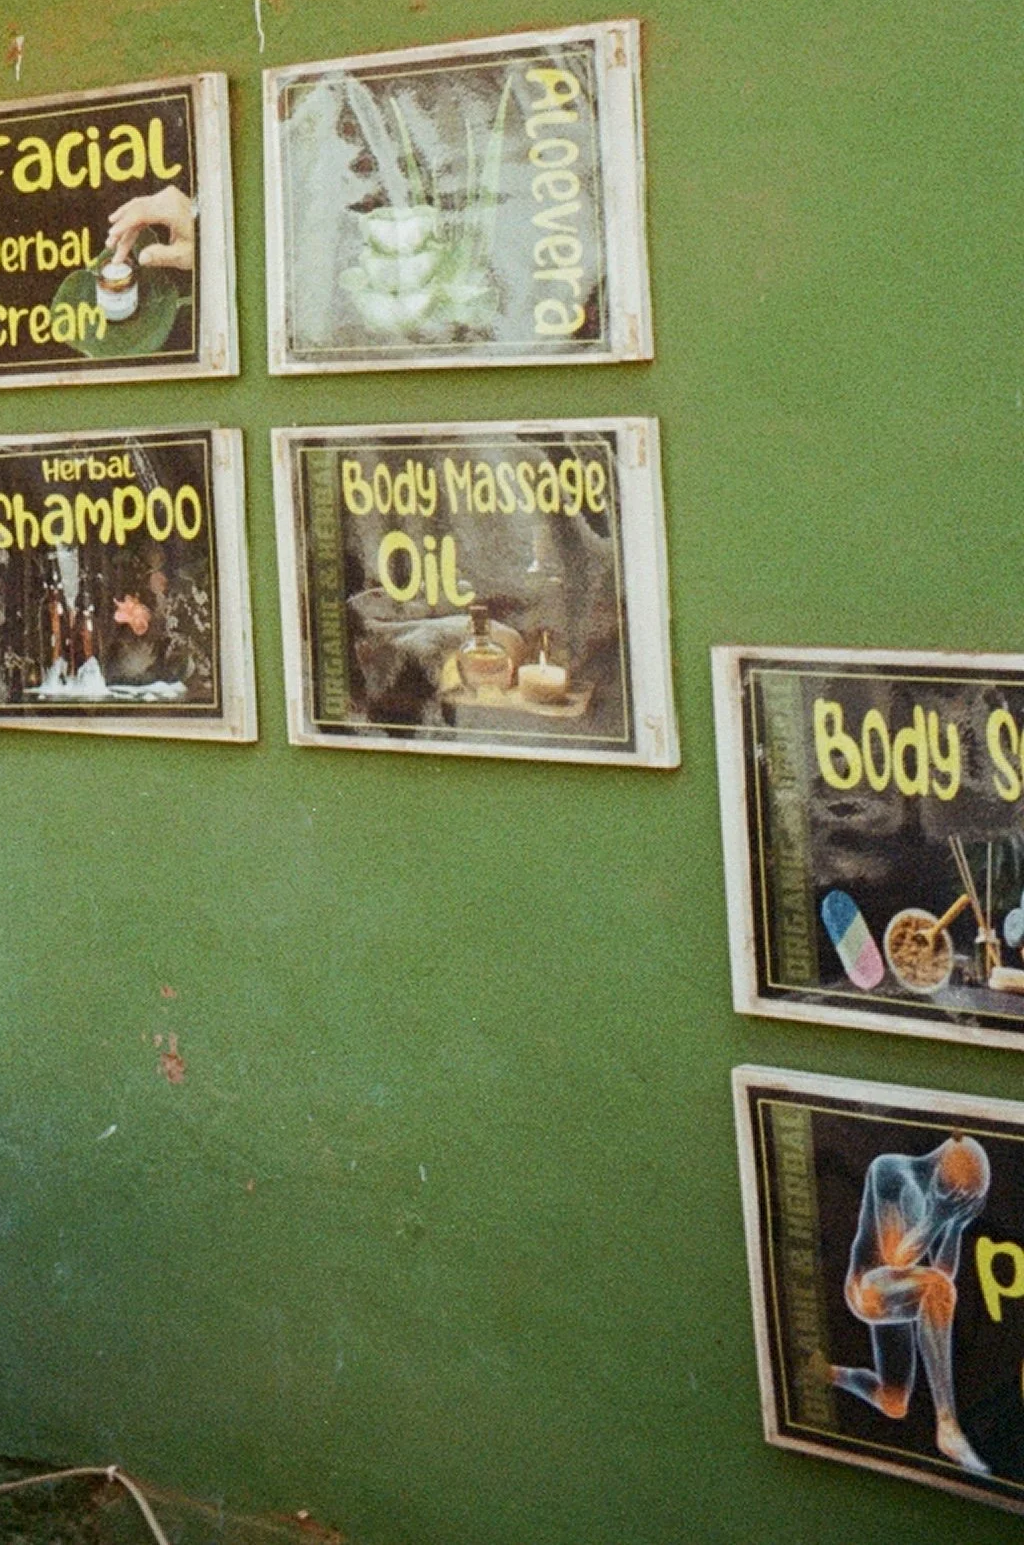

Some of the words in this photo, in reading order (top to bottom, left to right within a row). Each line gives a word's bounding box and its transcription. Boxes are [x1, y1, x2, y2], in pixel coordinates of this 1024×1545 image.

[42, 454, 136, 483] Herbal
[342, 457, 438, 518] Body
[446, 457, 608, 516] Massage
[377, 529, 475, 608] Oil
[813, 697, 961, 802] Body
[985, 699, 1024, 801] S
